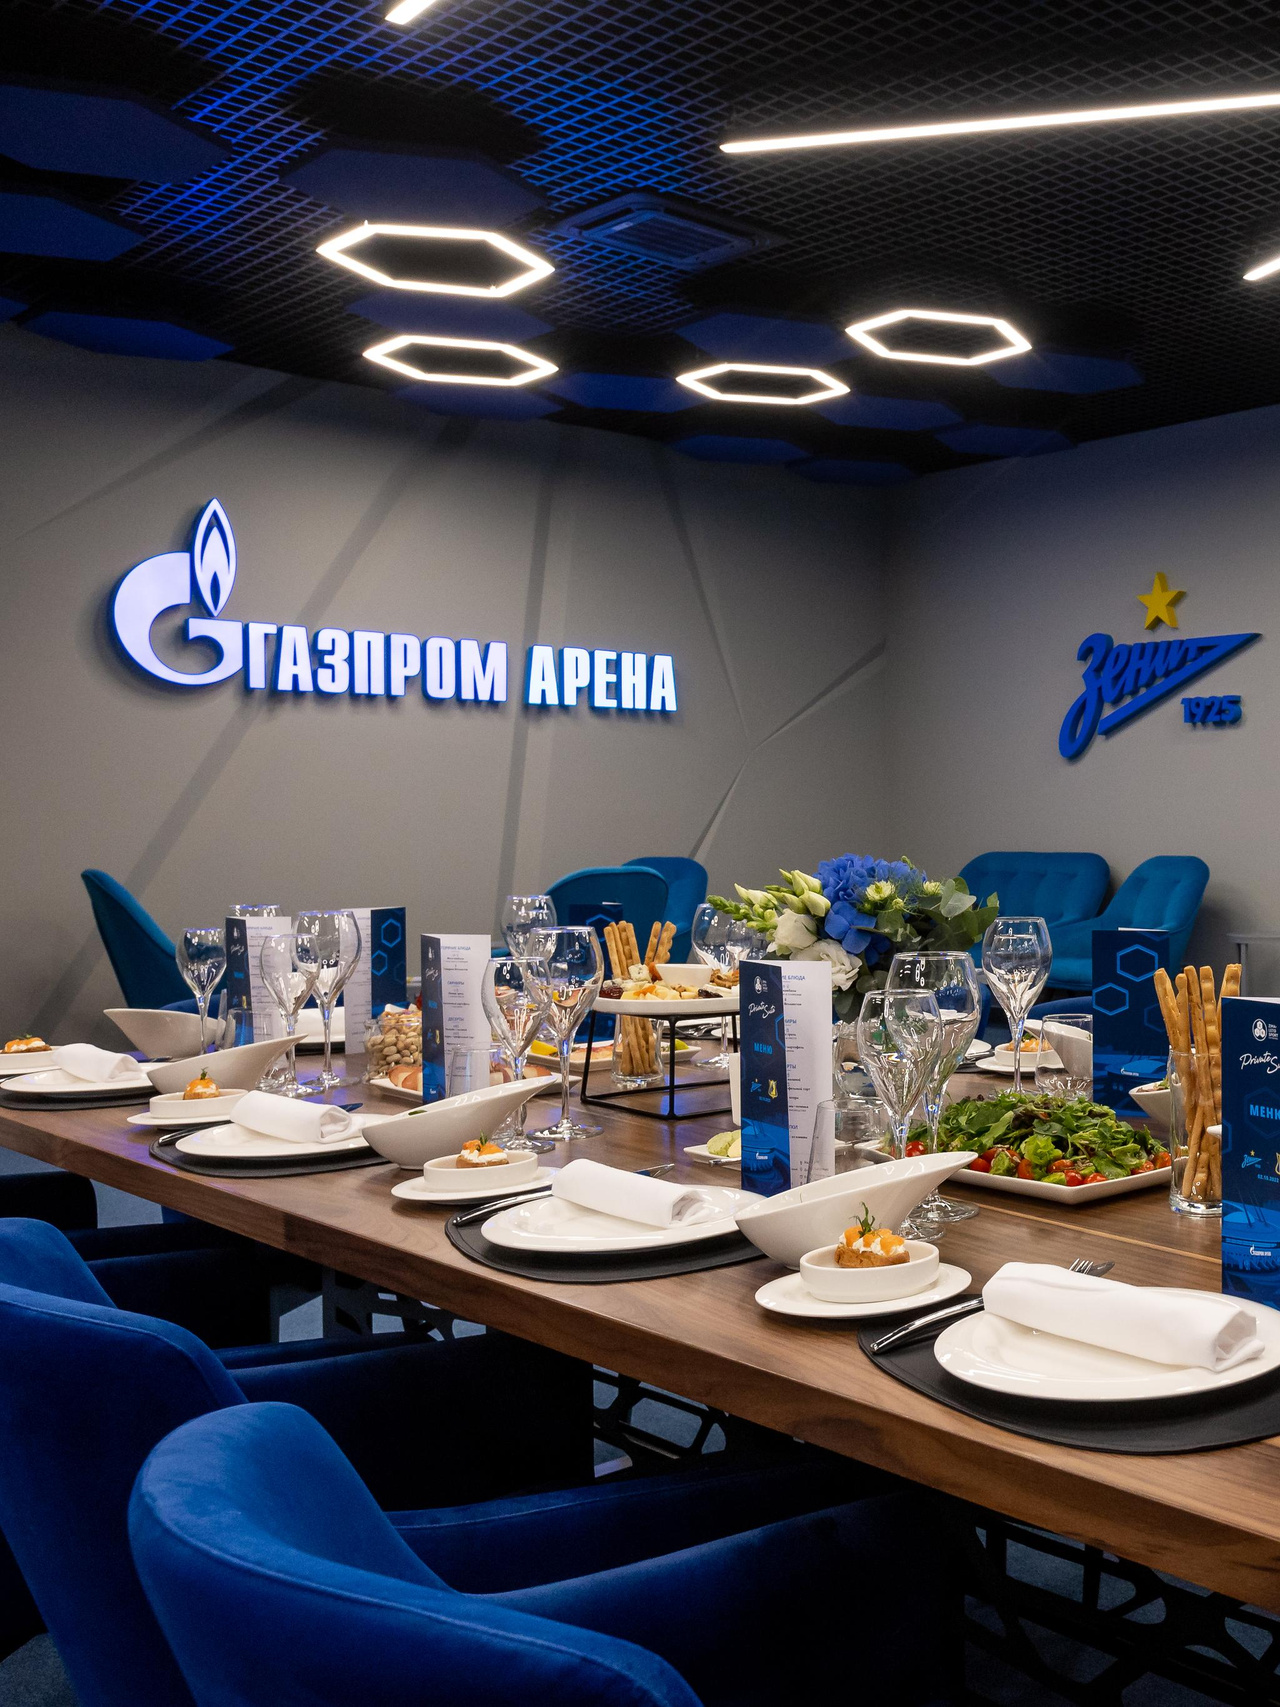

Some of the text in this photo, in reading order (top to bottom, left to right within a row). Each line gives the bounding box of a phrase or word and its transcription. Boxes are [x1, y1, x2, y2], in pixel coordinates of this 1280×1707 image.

[243, 620, 679, 713] ГАЗПРОМ АРЕНА
[1181, 694, 1243, 725] 1925
[753, 1042, 773, 1055] МЕНЮ
[1239, 1051, 1272, 1070] Private
